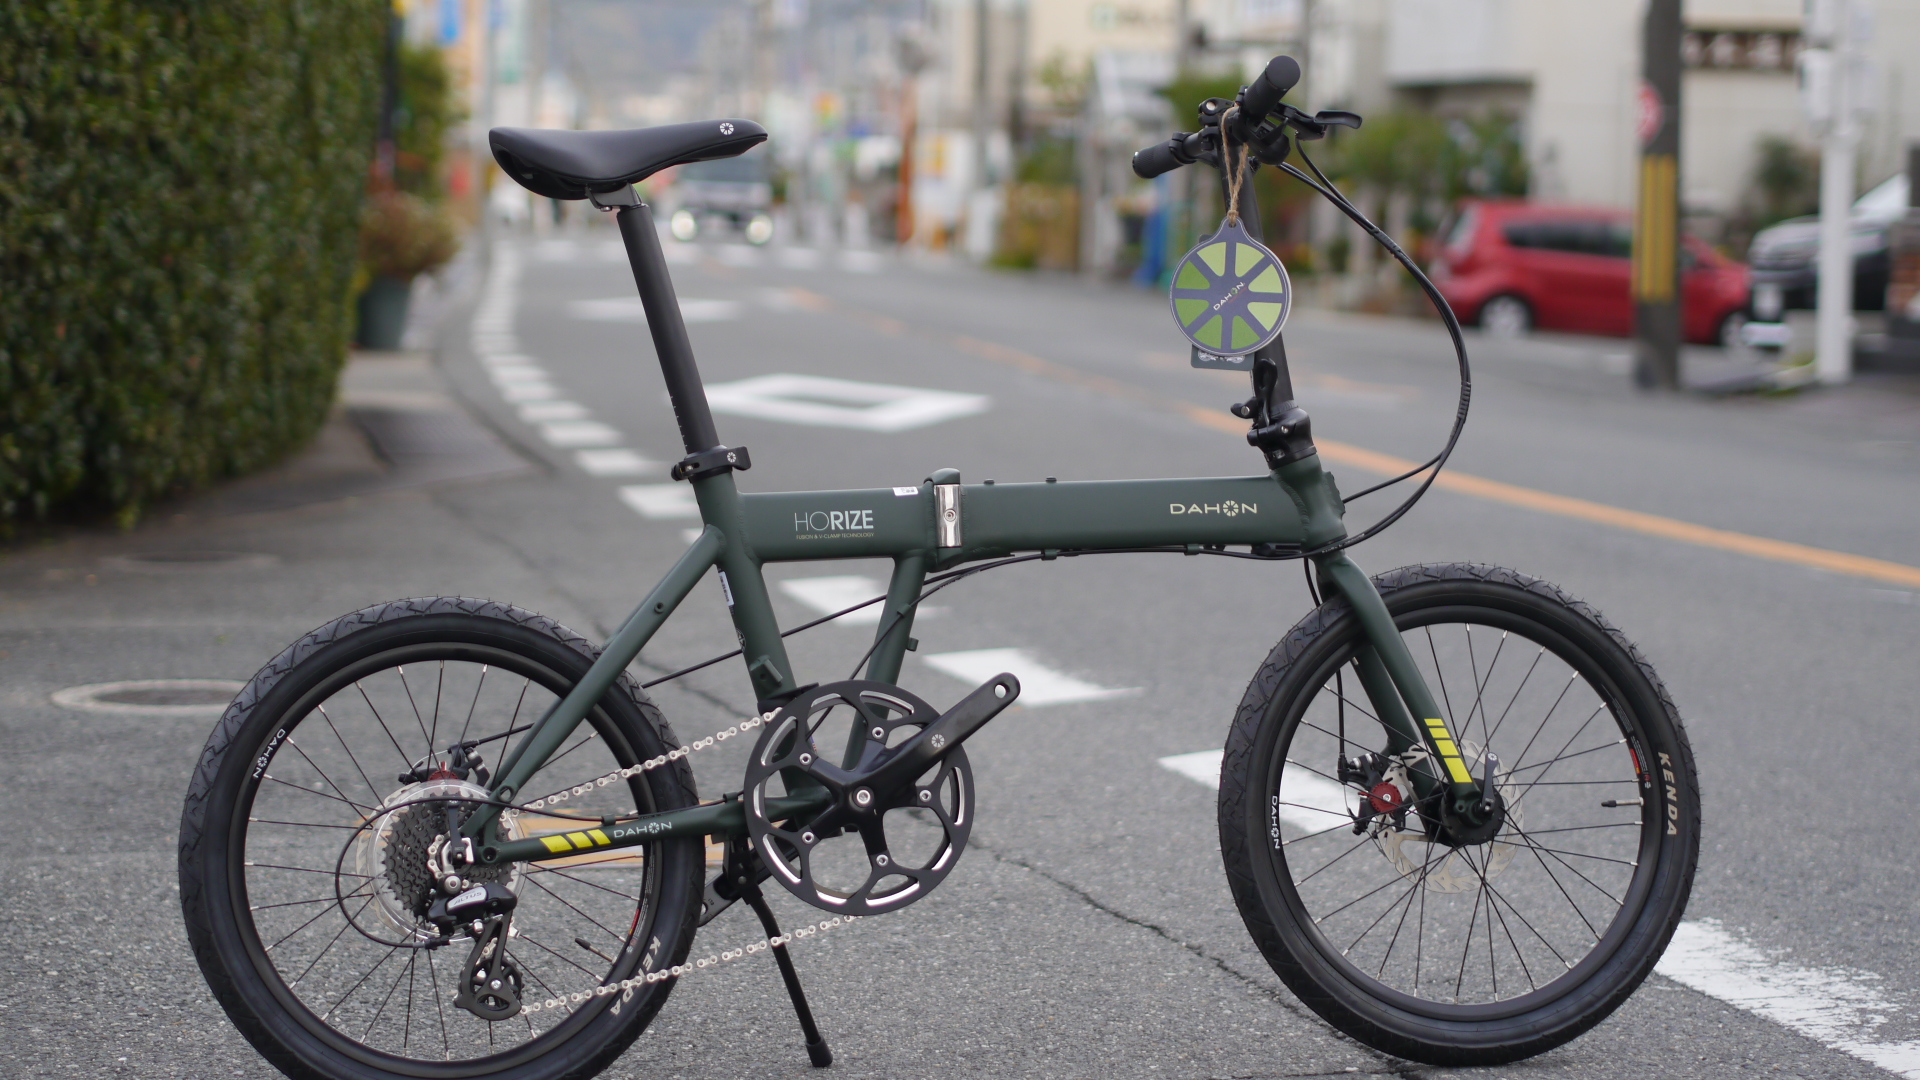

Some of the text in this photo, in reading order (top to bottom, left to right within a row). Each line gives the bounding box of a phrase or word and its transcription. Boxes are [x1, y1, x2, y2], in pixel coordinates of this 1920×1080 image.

[1213, 281, 1245, 311] DAHON
[794, 509, 874, 531] HORIZE
[1169, 500, 1258, 517] DAHON
[252, 728, 287, 779] DAHON
[1658, 752, 1678, 835] KENDA
[613, 821, 673, 839] DAHON
[1270, 795, 1281, 849] DAHON
[453, 892, 482, 906] ALTUS
